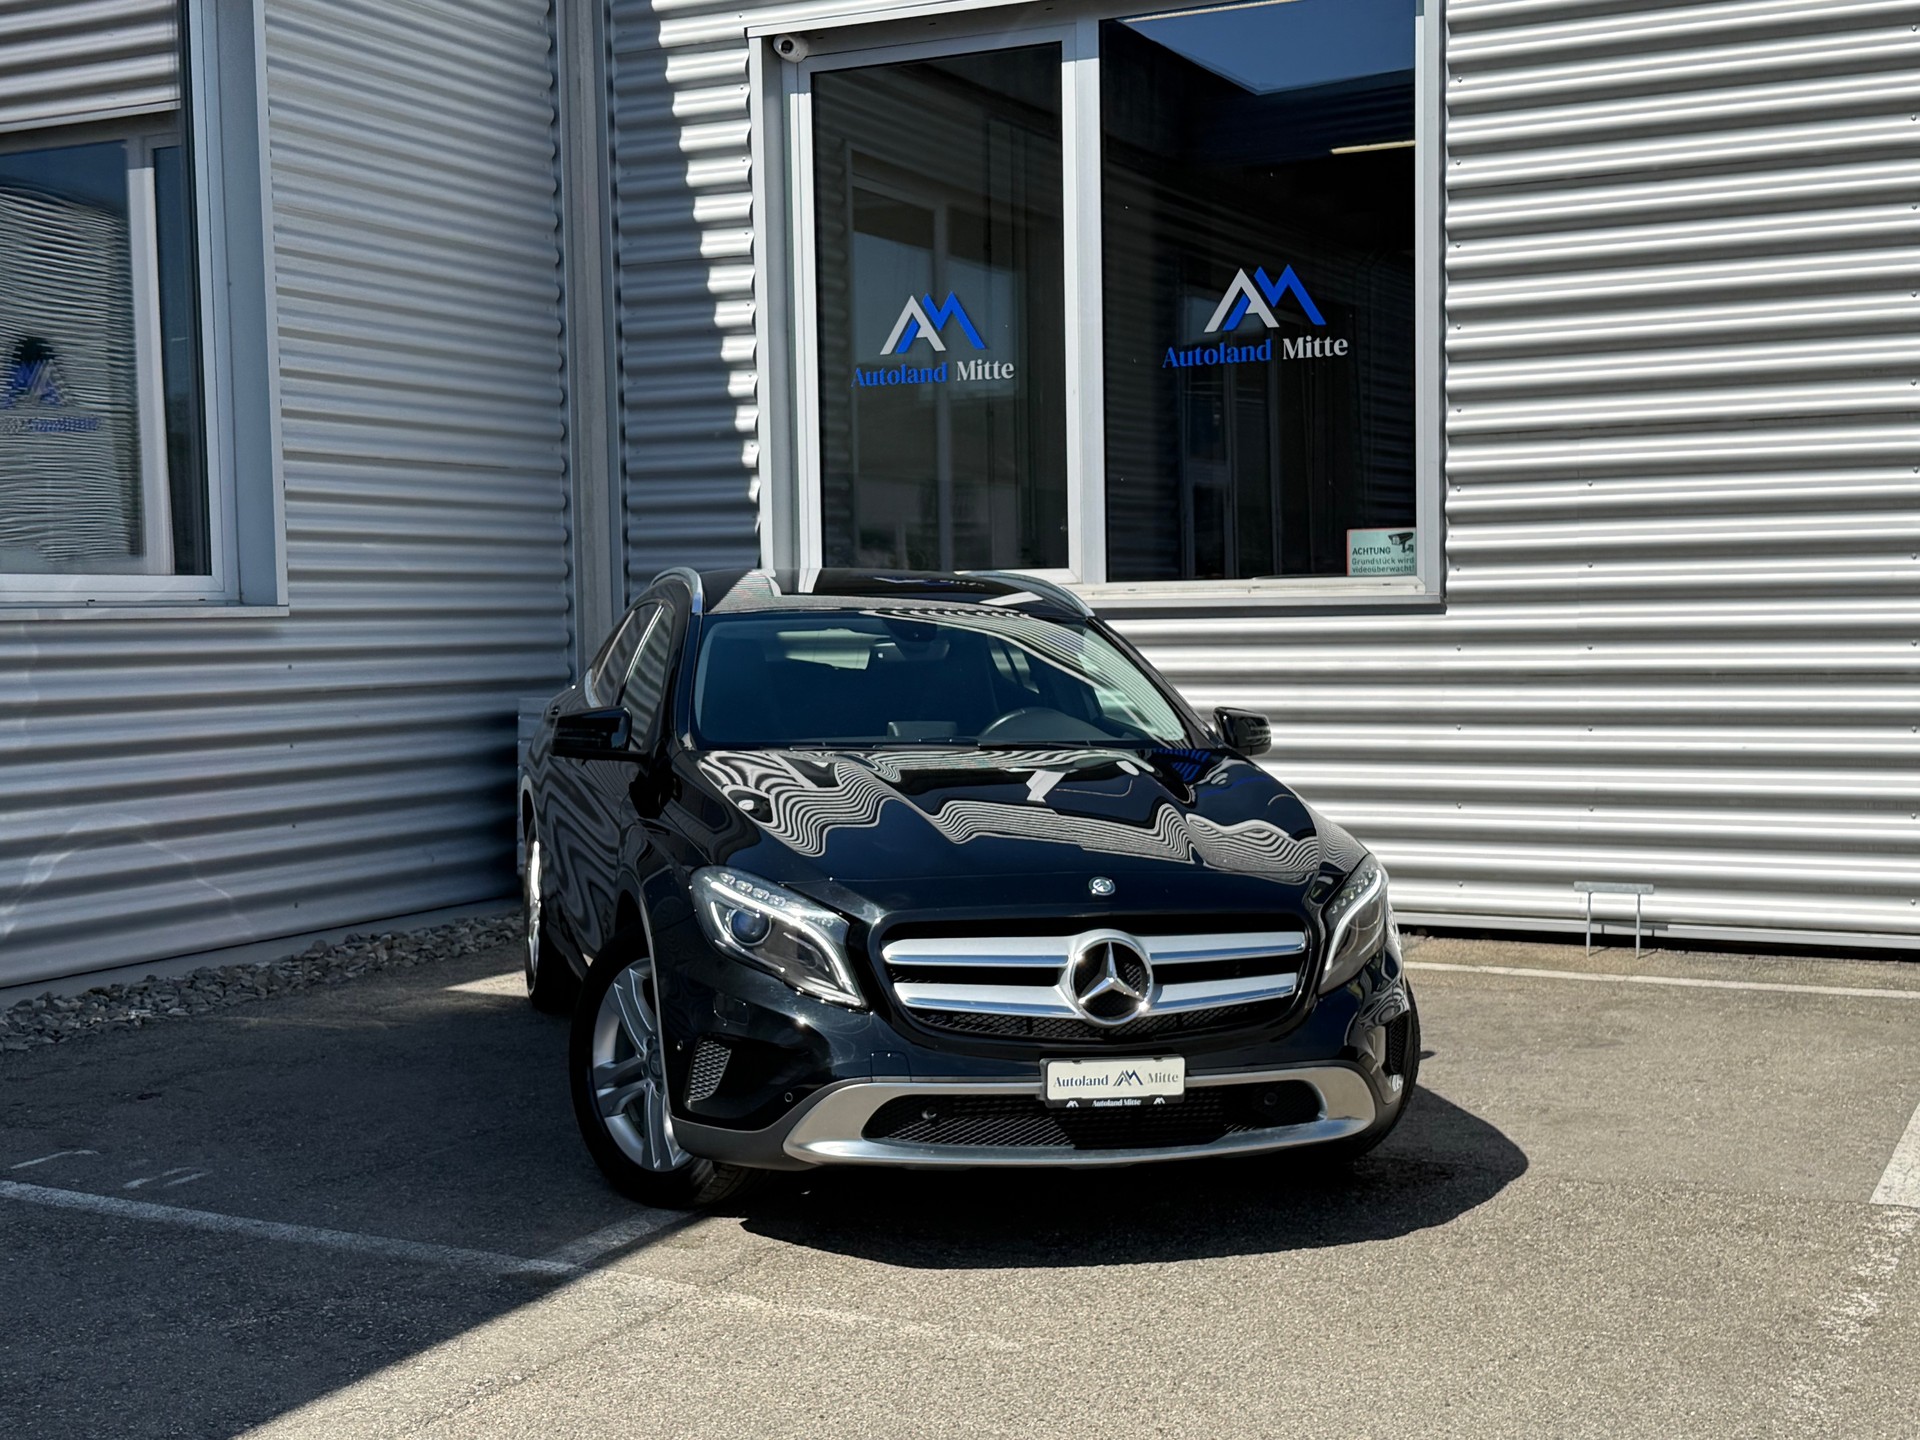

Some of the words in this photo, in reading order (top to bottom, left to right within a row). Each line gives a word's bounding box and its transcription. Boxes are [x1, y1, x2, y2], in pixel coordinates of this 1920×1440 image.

[1162, 338, 1272, 369] Autoland
[1282, 335, 1349, 360] Mitte
[851, 361, 948, 388] Autoland
[957, 358, 1015, 382] Mitte
[1352, 546, 1391, 555] ACHTUNG
[1352, 557, 1396, 565] Grundstück
[1397, 556, 1414, 564] wird
[1054, 1075, 1109, 1088] Autoland
[1147, 1071, 1179, 1084] Mitte
[1092, 1099, 1122, 1107] Autoland
[1124, 1098, 1142, 1106] Mitte
